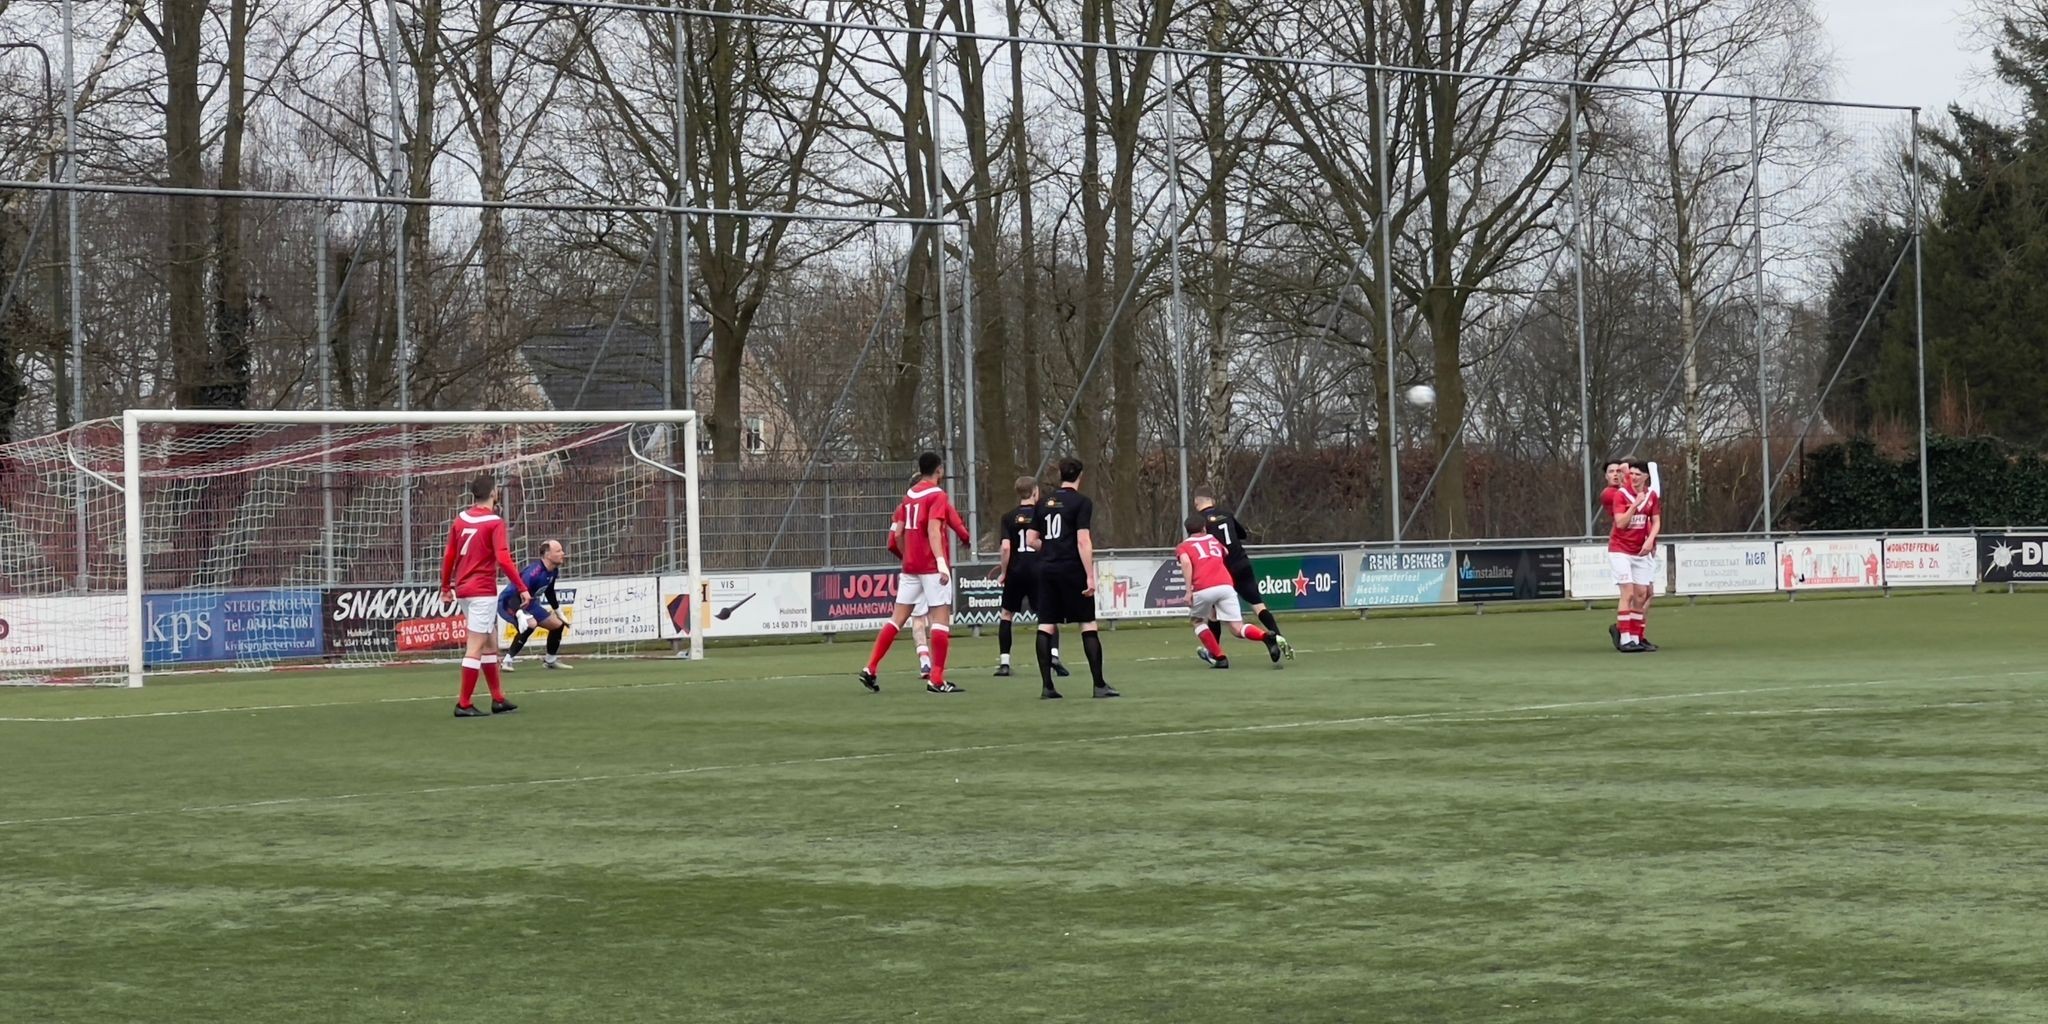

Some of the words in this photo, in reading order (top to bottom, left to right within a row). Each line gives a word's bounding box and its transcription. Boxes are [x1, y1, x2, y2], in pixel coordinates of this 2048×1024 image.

[905, 503, 920, 530] 11
[1044, 513, 1061, 540] 10
[1218, 523, 1231, 545] 7
[460, 528, 478, 556] 7
[1017, 529, 1035, 552] 1
[1192, 540, 1223, 559] 15
[1402, 553, 1445, 569] DEKKER
[1919, 558, 1924, 569] &
[720, 580, 735, 589] VIS
[1257, 575, 1291, 595] eken
[224, 598, 314, 613] STEIGERBOUW
[333, 587, 463, 621] SNACKYWO
[828, 602, 895, 616] AANHANGWA
[144, 600, 212, 654] kps
[224, 618, 245, 632] Tel.
[414, 634, 435, 643] WOK
[437, 632, 450, 640] TO
[452, 629, 466, 640] GO
